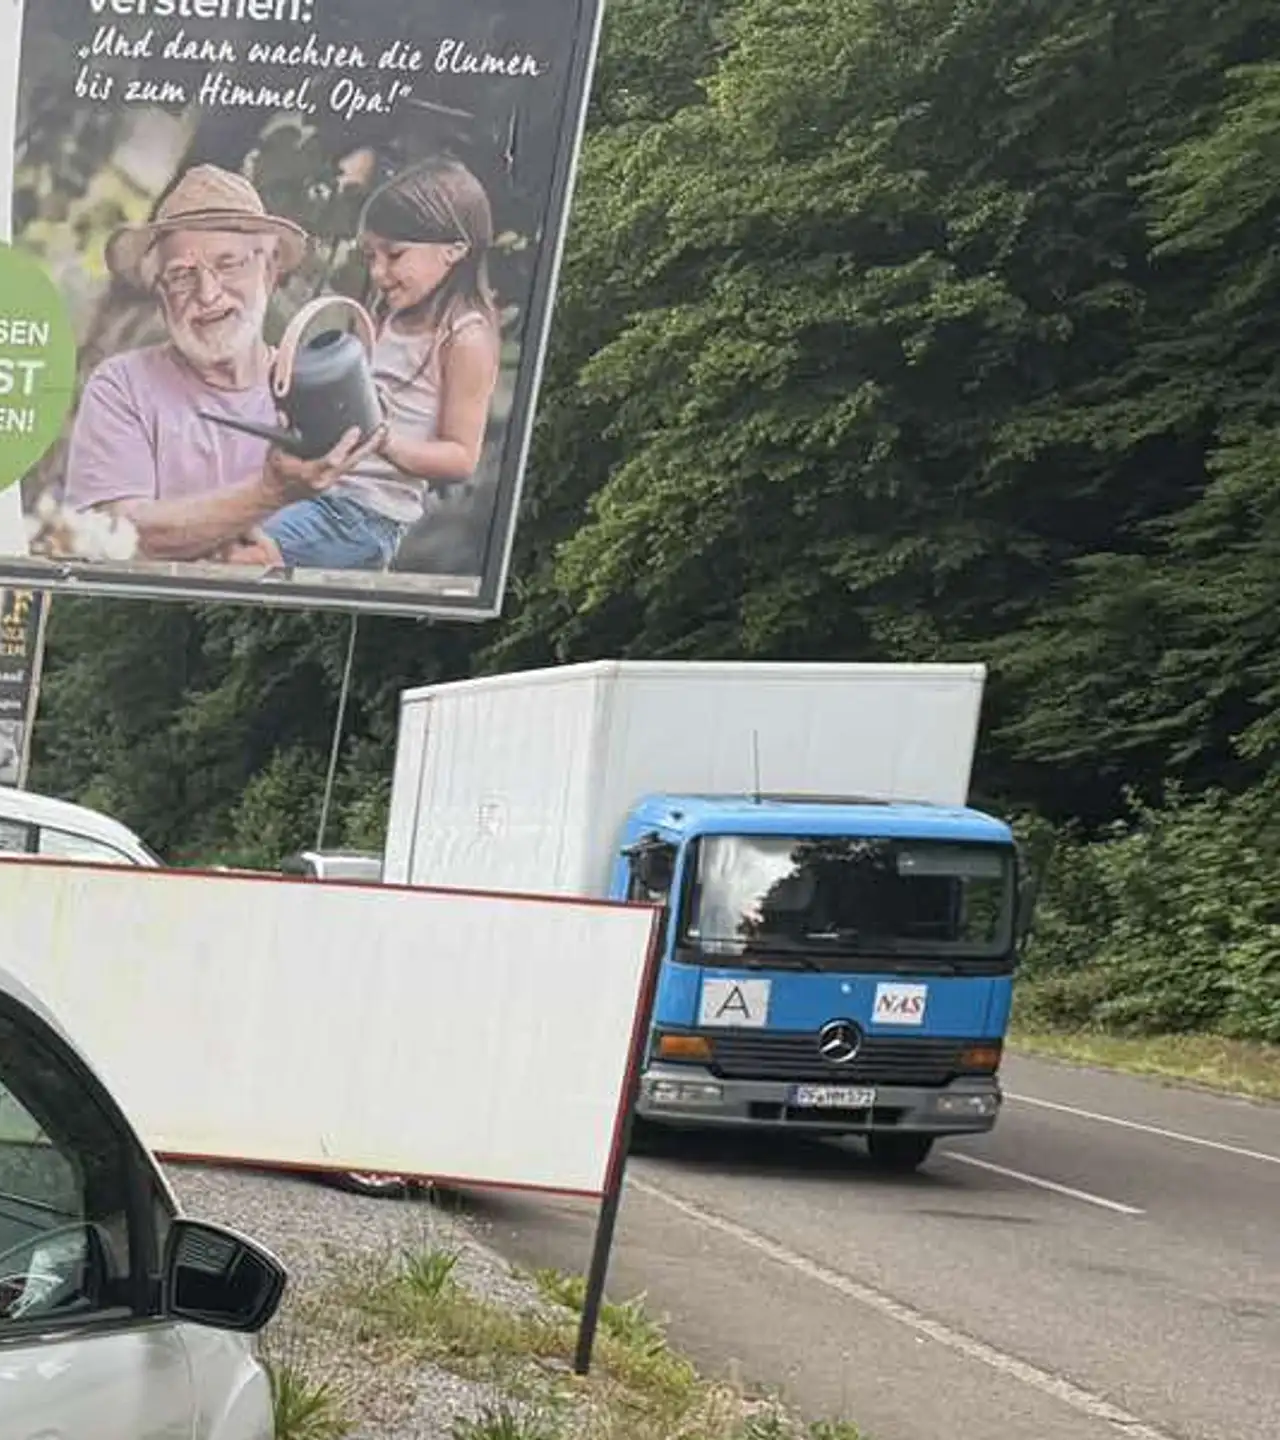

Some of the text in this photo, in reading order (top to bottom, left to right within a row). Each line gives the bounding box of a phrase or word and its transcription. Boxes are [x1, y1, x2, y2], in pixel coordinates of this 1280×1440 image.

[163, 28, 237, 62] dann
[248, 34, 366, 69] wachsen
[378, 38, 423, 72] die
[433, 38, 540, 78] Blumen
[75, 67, 115, 100] bis
[125, 79, 186, 103] zum
[199, 74, 316, 115] Himmel,
[715, 985, 751, 1018] A
